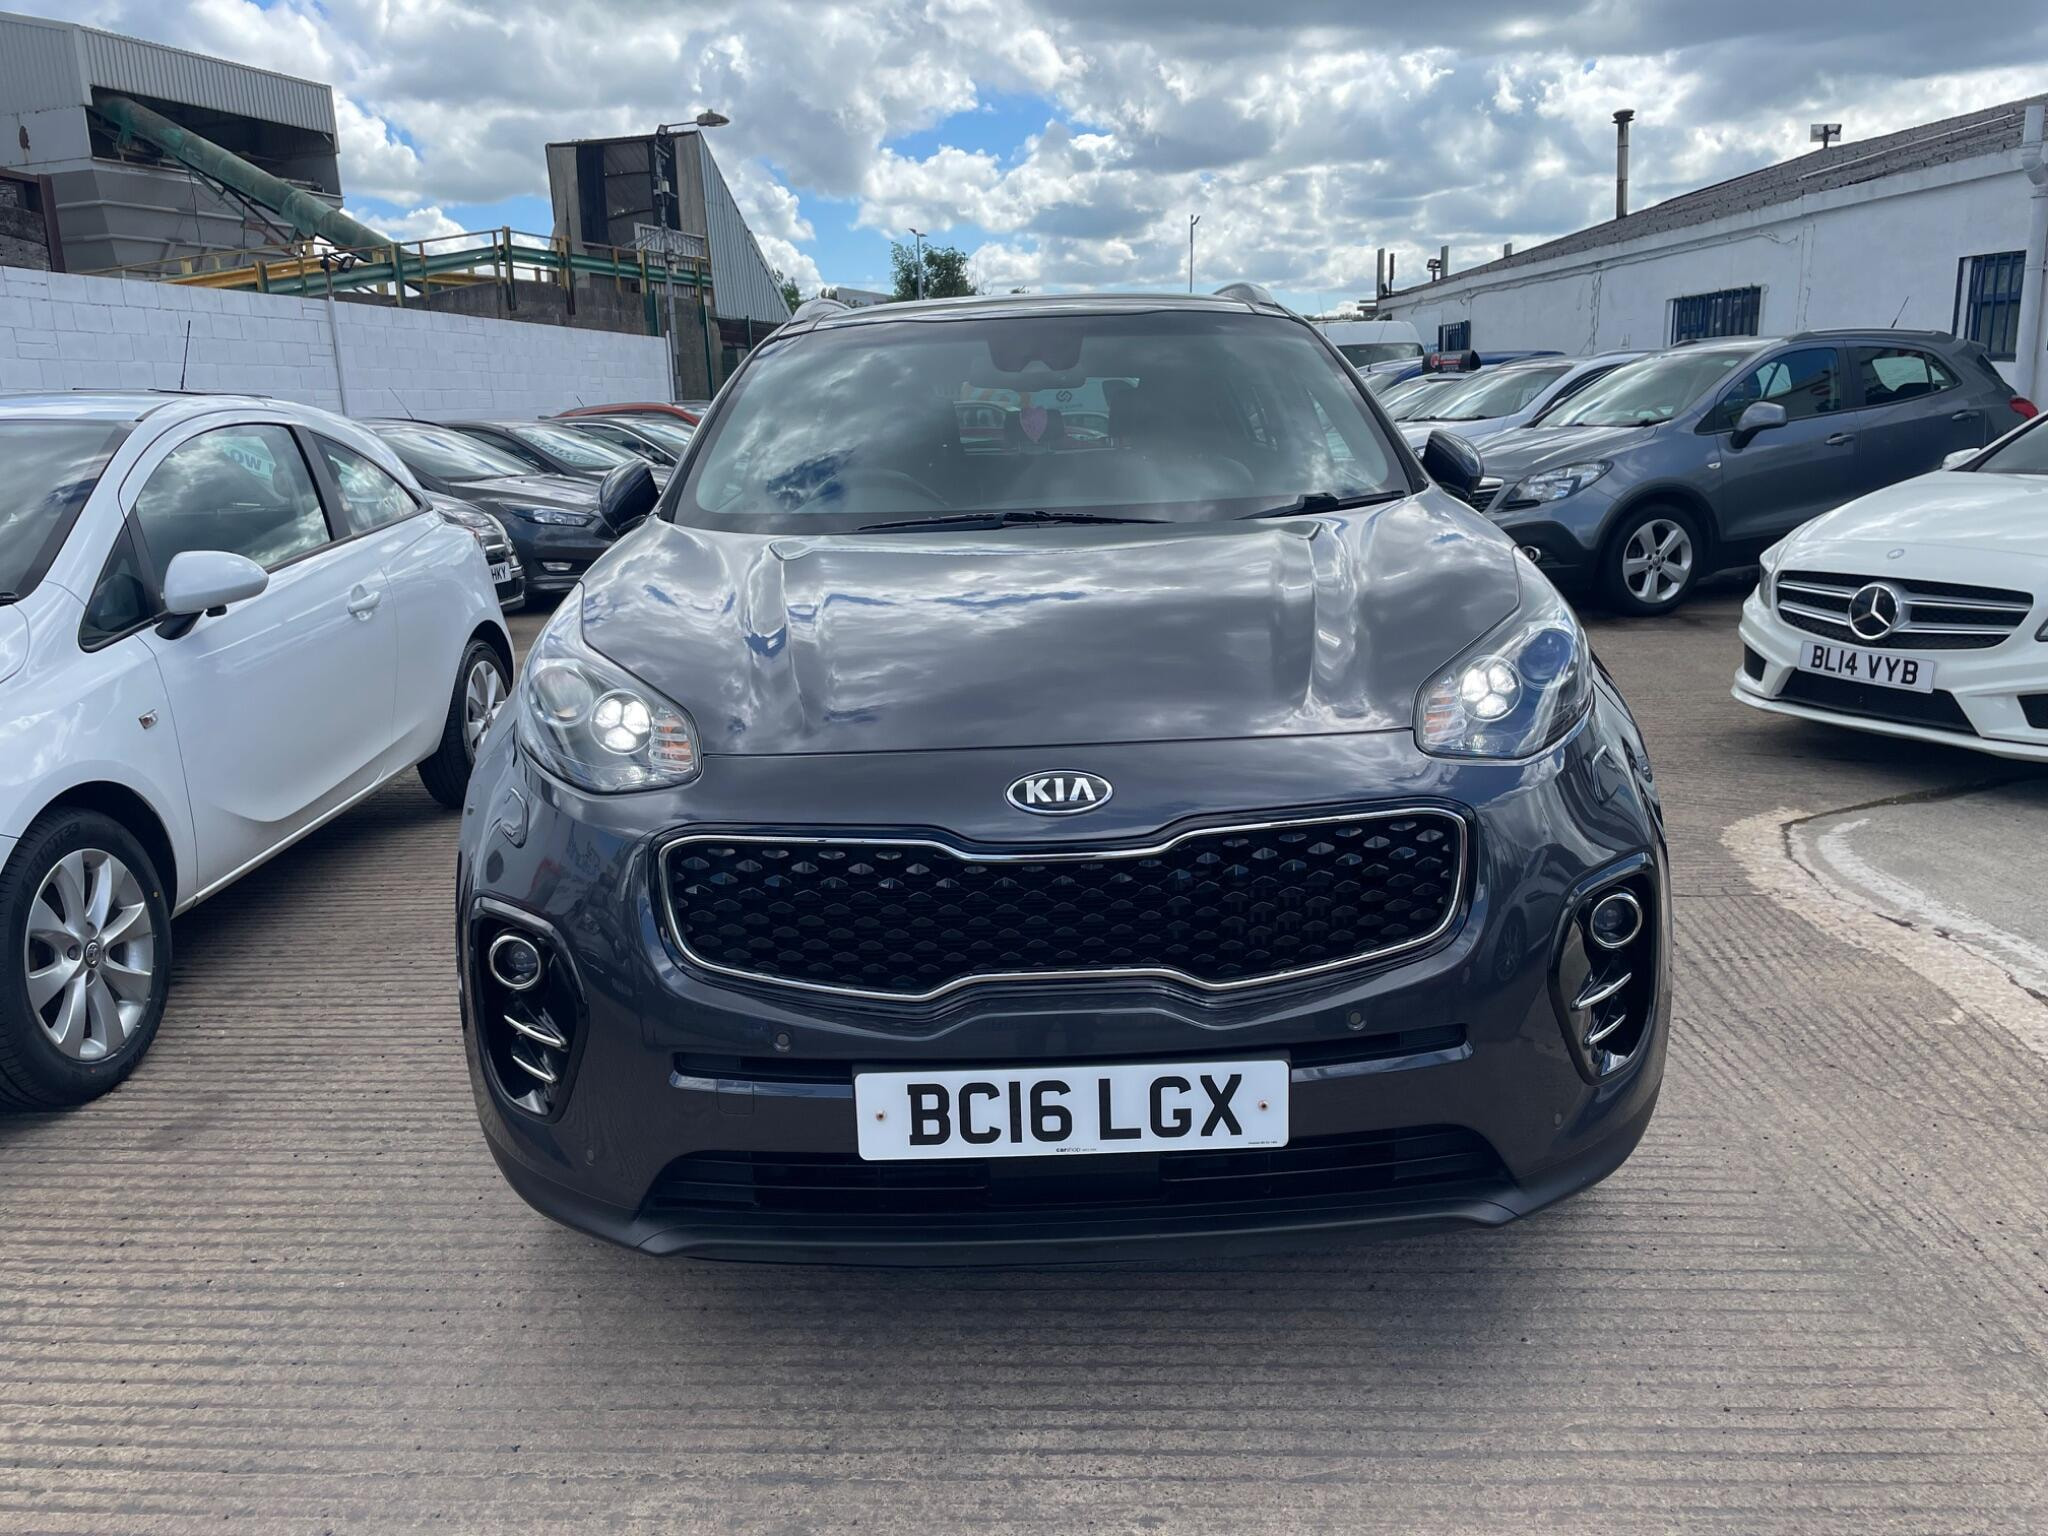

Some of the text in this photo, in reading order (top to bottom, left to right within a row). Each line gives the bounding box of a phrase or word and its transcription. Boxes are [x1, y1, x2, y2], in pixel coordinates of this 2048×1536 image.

[491, 566, 506, 581] HKY
[1811, 645, 1919, 685] BL14 VYB
[1025, 777, 1096, 804] KIA
[907, 1073, 1243, 1146] BC16 LGX
